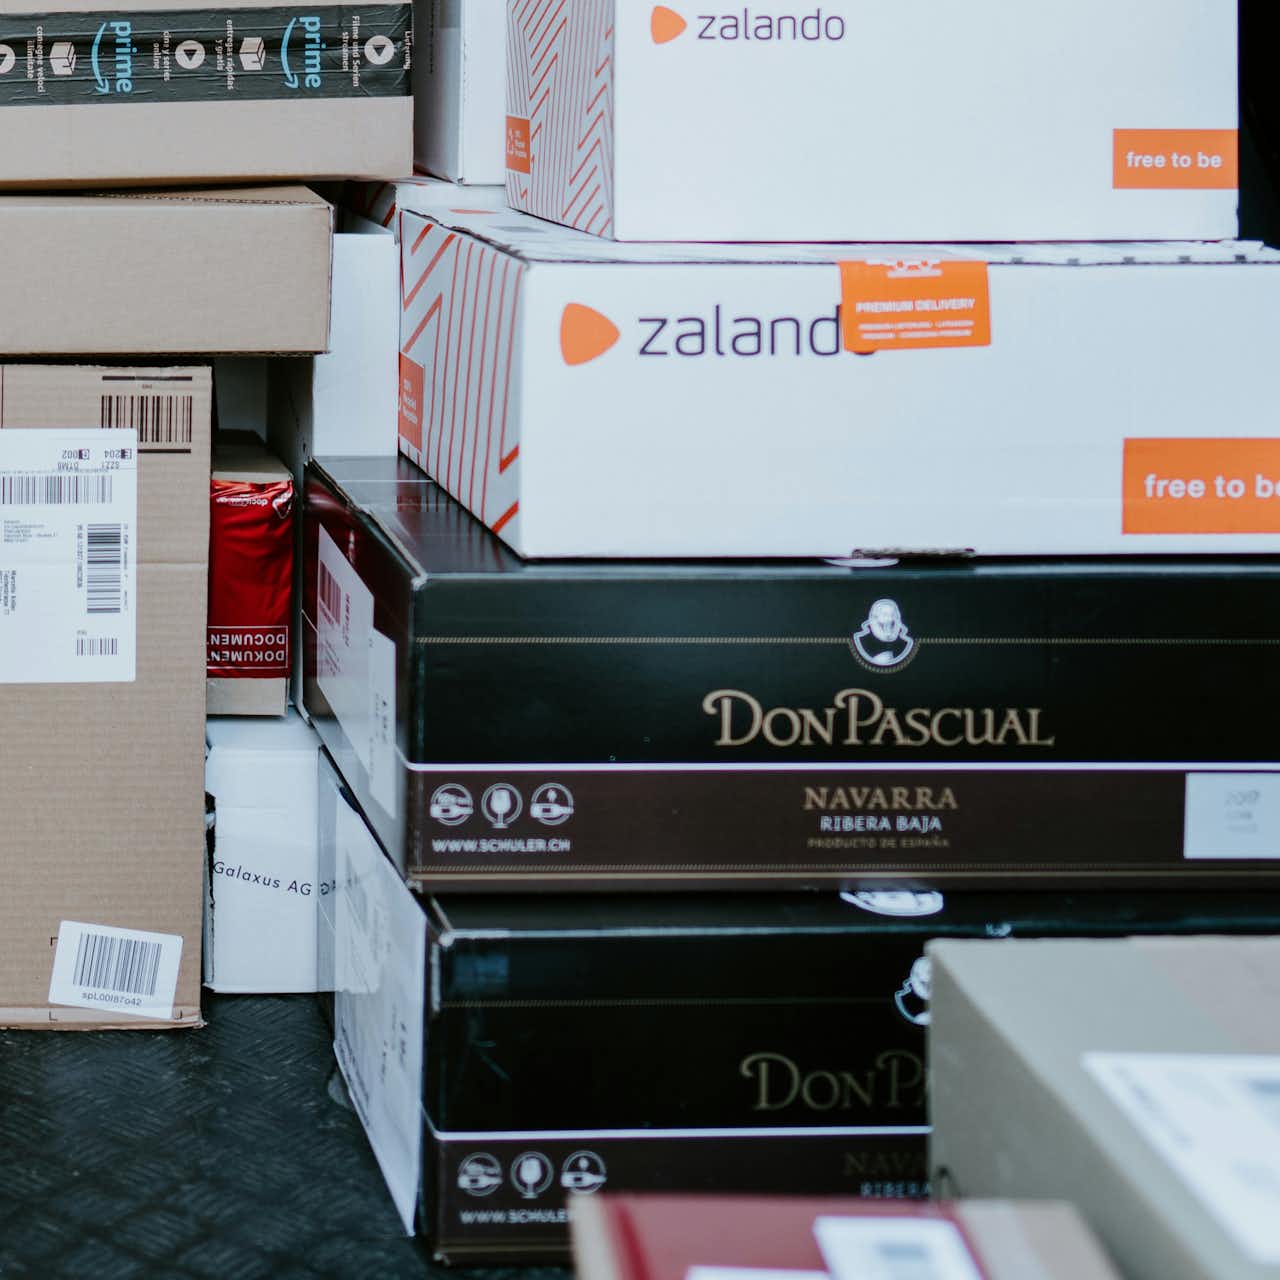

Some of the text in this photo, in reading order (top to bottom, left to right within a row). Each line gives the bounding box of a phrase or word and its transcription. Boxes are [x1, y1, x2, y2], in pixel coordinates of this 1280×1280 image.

[695, 7, 845, 42] zalando
[223, 20, 234, 56] entregas
[352, 15, 360, 87] Filme und Serien
[110, 21, 136, 93] prime
[152, 43, 161, 69] online
[215, 45, 225, 71] gratis
[299, 16, 326, 89] prime
[341, 31, 350, 72] streamen
[36, 67, 46, 93] veloci
[162, 56, 170, 82] series
[1125, 149, 1223, 169] free to be
[855, 298, 976, 313] PREMIUM DELIVERY
[637, 303, 877, 357] zaland
[1144, 474, 1280, 500] free to b
[206, 633, 285, 646] DOCUMEN
[206, 650, 285, 662] DOKUMEN
[804, 786, 958, 810] NAVARRA
[820, 816, 942, 833] RIBERA BAJA
[432, 838, 571, 853] WWW.SCHULER.CH
[808, 837, 875, 848] PRODUCTO
[881, 837, 898, 848] DE
[213, 860, 281, 891] Galaxus
[287, 879, 312, 898] AG
